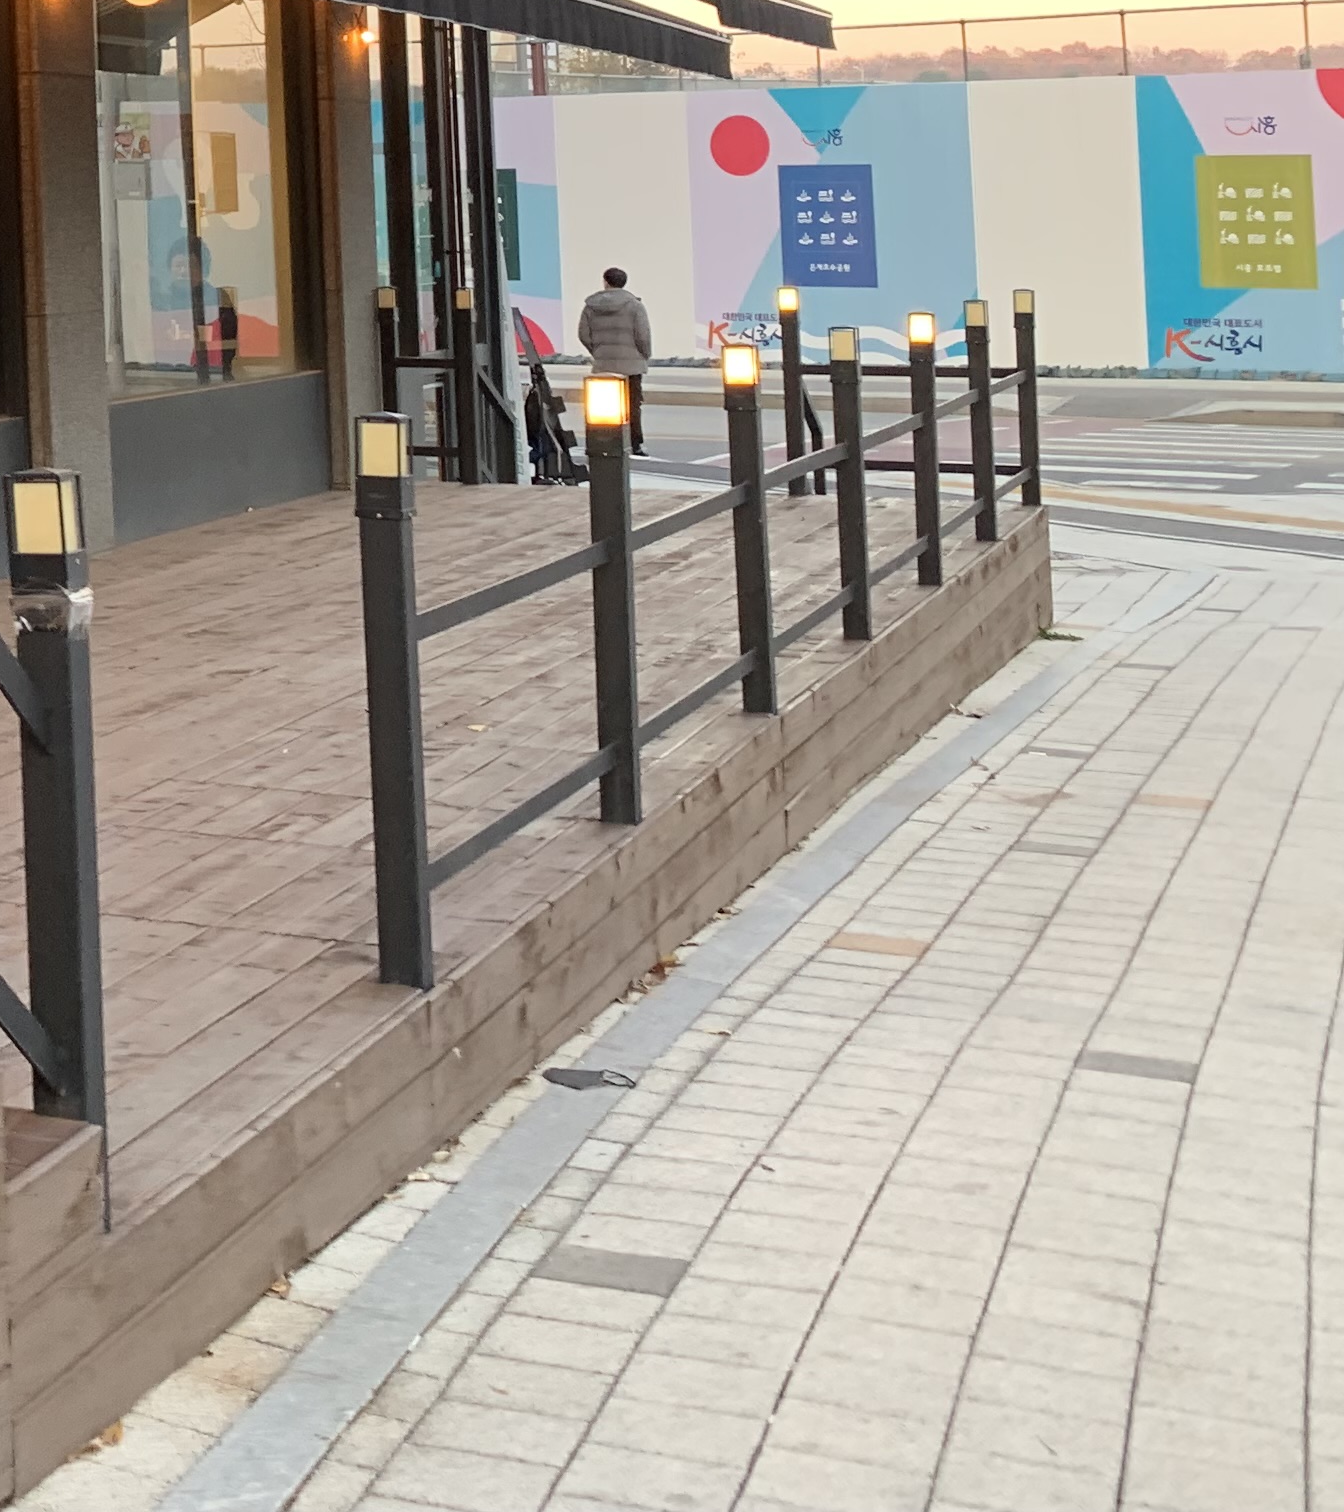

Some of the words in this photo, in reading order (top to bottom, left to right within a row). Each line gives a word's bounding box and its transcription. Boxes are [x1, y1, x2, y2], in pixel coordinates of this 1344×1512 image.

[722, 312, 753, 321] 대한민국
[755, 312, 779, 322] 대표도
[1183, 318, 1221, 328] 대한민국
[1223, 318, 1263, 328] 대표도시
[1165, 327, 1263, 362] K-시흥시
